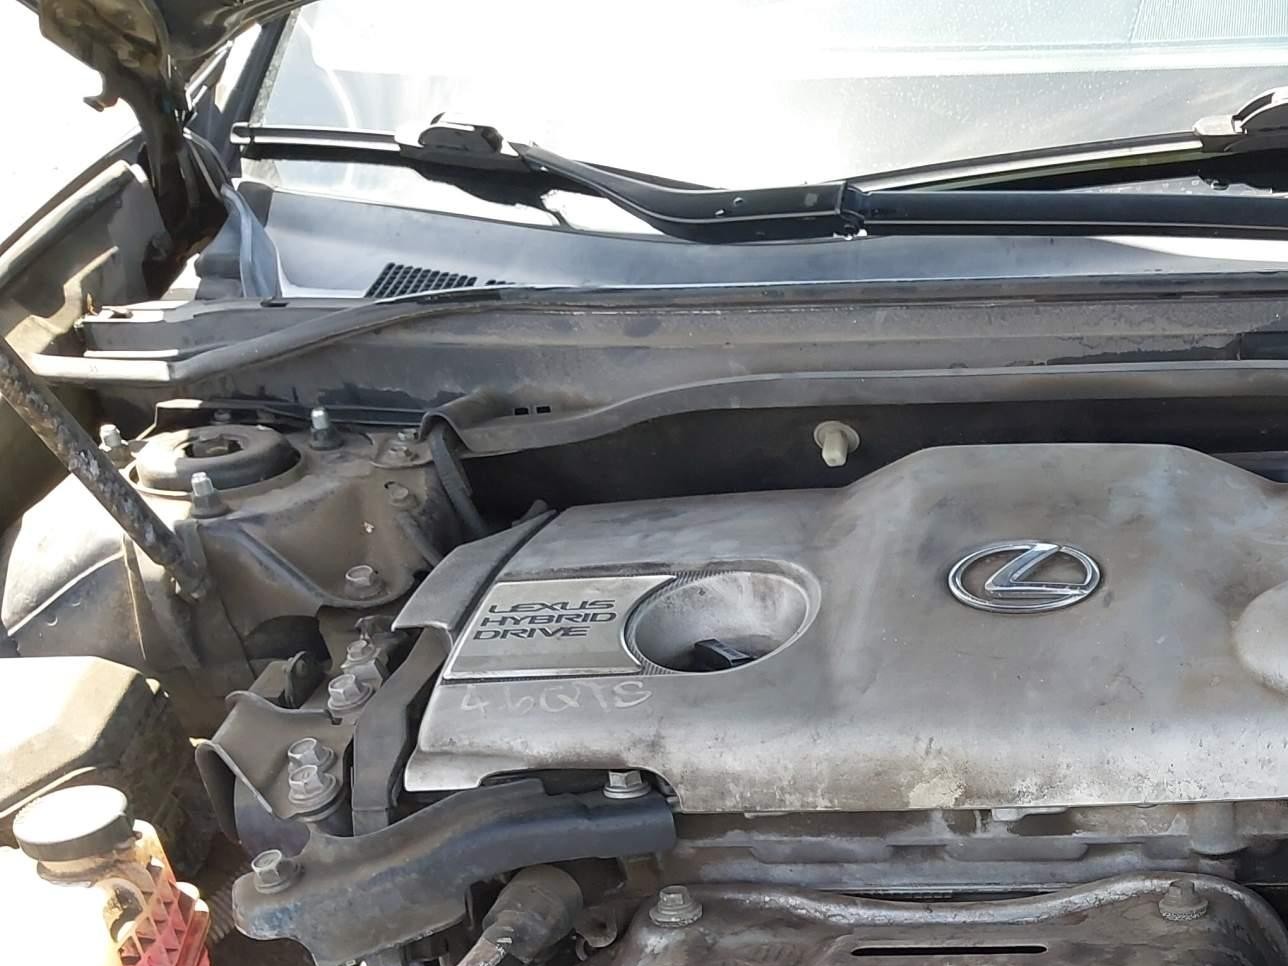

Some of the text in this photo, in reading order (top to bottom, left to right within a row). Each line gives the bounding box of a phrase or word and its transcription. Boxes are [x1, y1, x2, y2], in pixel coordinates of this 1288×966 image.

[488, 599, 616, 614] LEXUS
[479, 612, 617, 627] HYBRID
[472, 626, 591, 641] DRIVE
